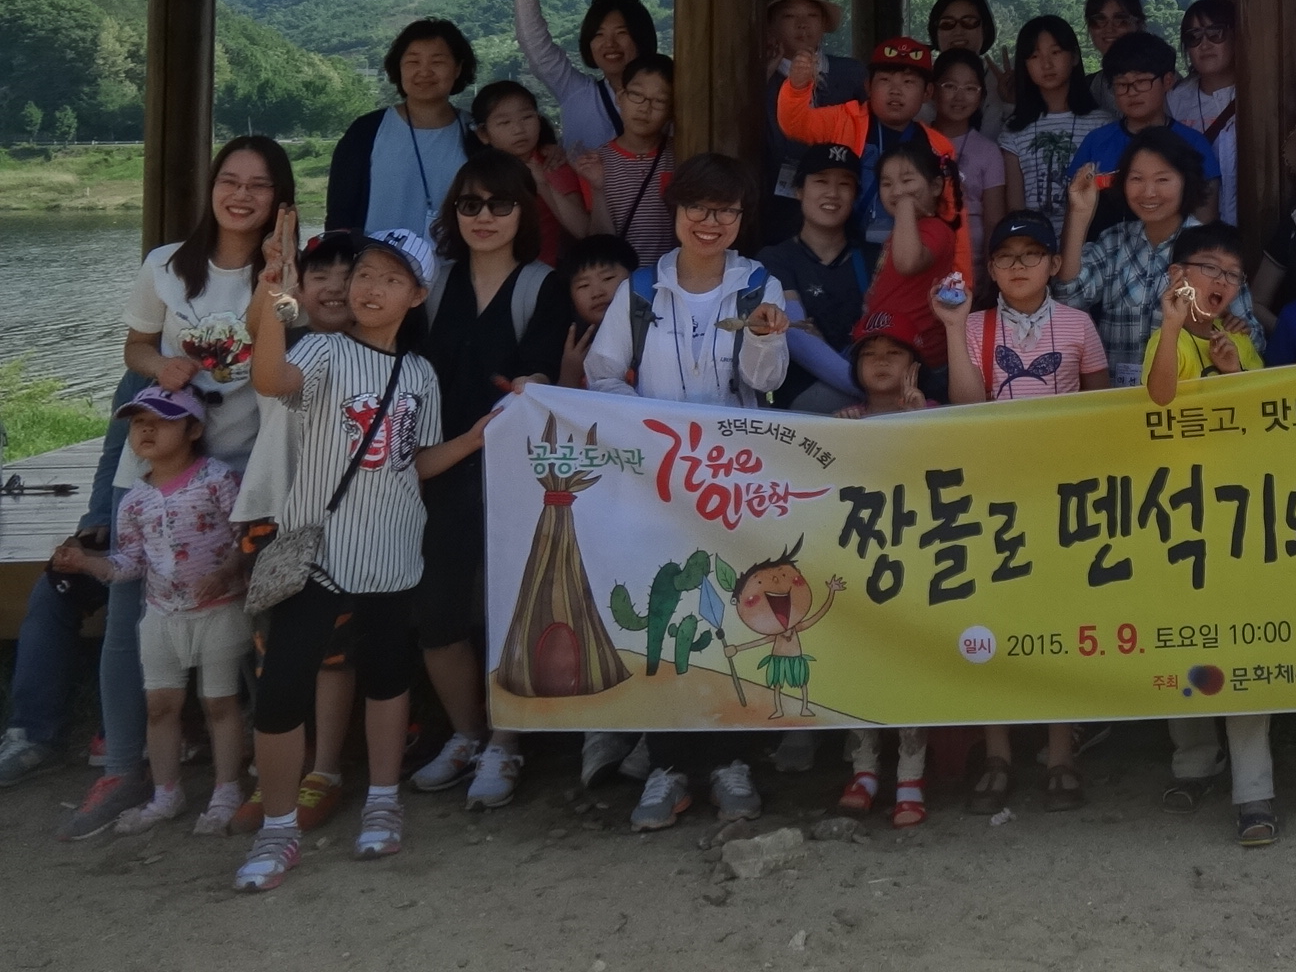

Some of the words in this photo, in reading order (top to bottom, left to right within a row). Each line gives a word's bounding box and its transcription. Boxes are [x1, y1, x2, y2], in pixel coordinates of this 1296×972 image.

[1146, 407, 1246, 441] 만들고,
[529, 444, 645, 476] 공공도서관
[717, 417, 796, 445] 장덕도서관
[798, 436, 836, 469] 제1회
[838, 468, 1033, 605] 짱돌로
[963, 638, 992, 655] 일시
[1007, 633, 1069, 657] 2015.
[1078, 624, 1106, 657] 5.
[1117, 623, 1145, 655] 9.
[1154, 623, 1220, 650] 토요일
[1229, 620, 1291, 646] 10:00
[1152, 674, 1179, 692] 주최
